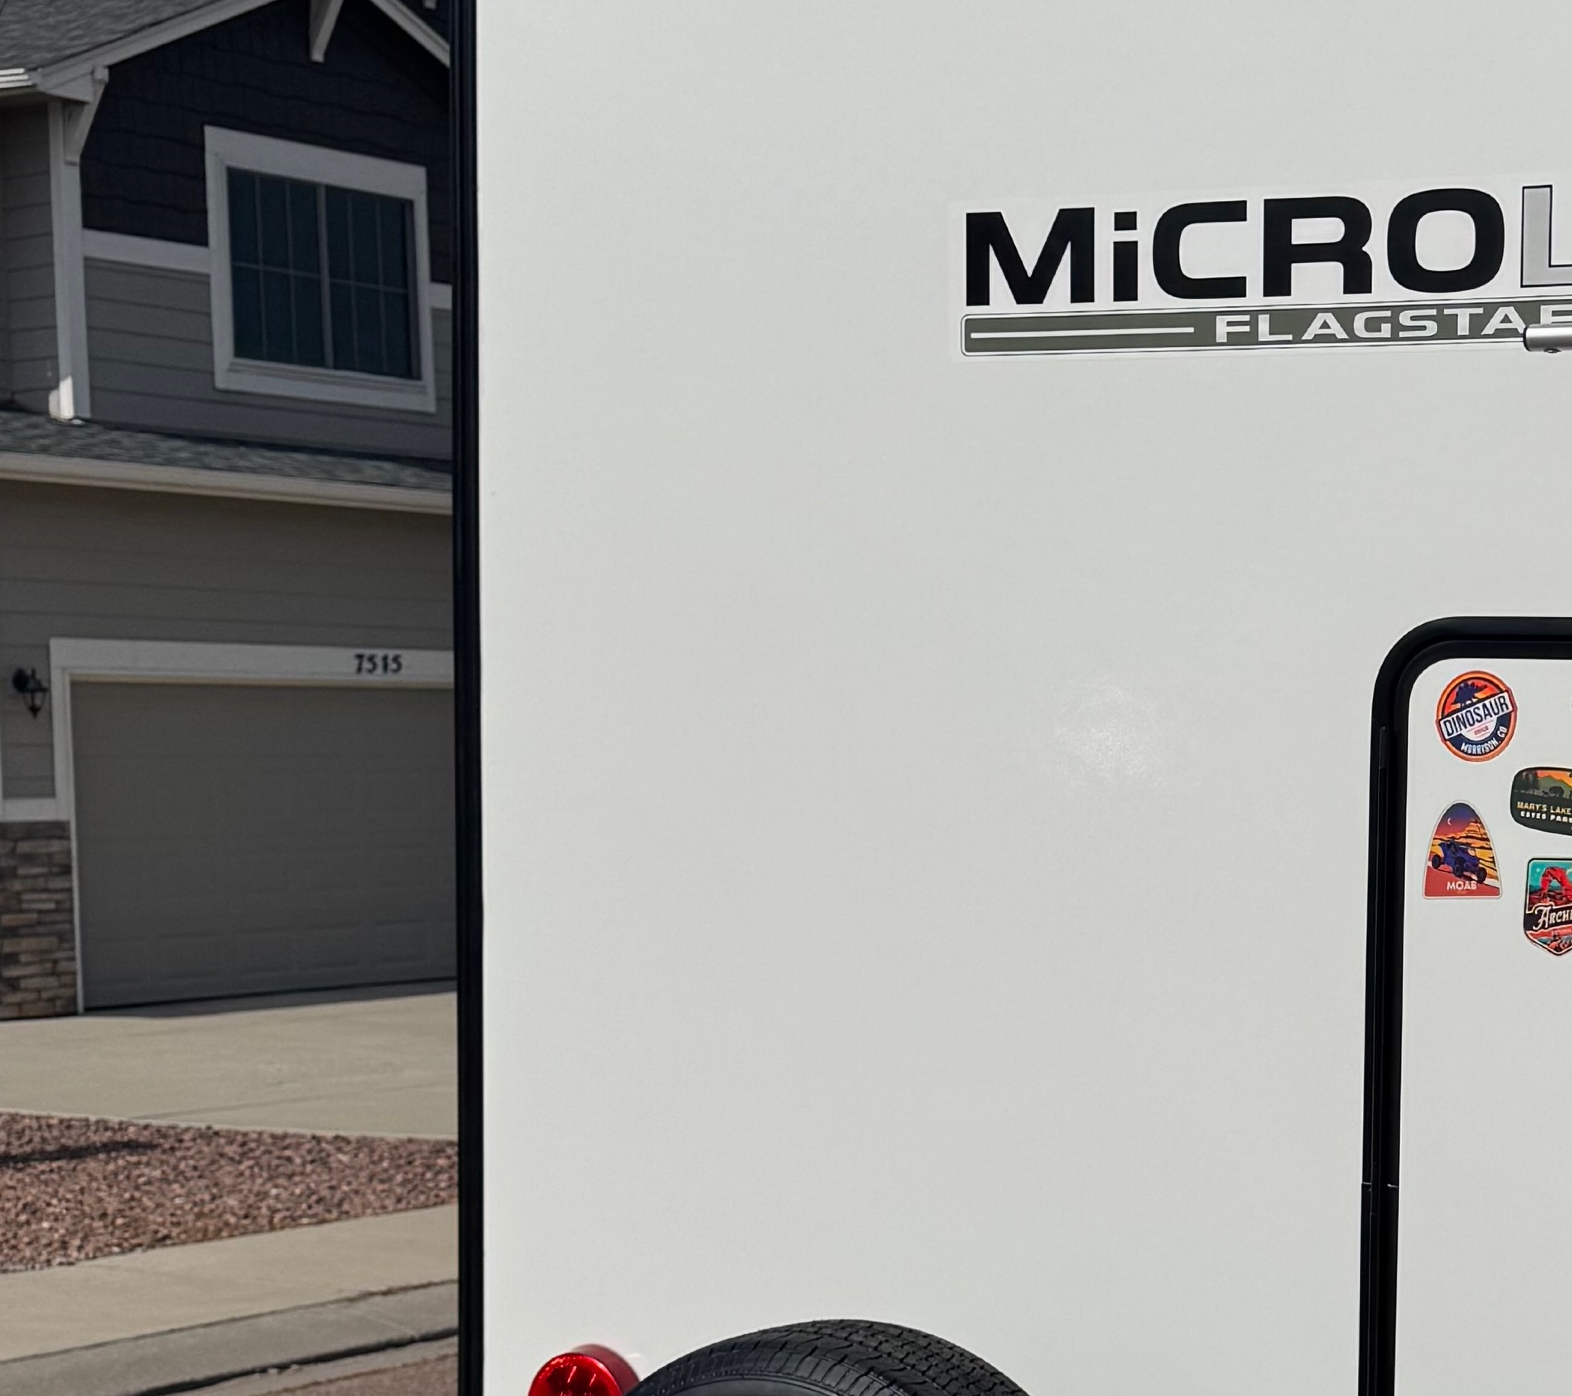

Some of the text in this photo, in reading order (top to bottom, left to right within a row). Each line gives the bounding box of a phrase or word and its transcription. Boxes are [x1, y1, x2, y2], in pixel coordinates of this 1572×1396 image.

[354, 653, 402, 674] 7515
[1442, 695, 1510, 737] DINOSAUR
[1516, 801, 1548, 812] MARY'S
[1550, 806, 1572, 815] LAKE
[1446, 881, 1478, 891] MOAB
